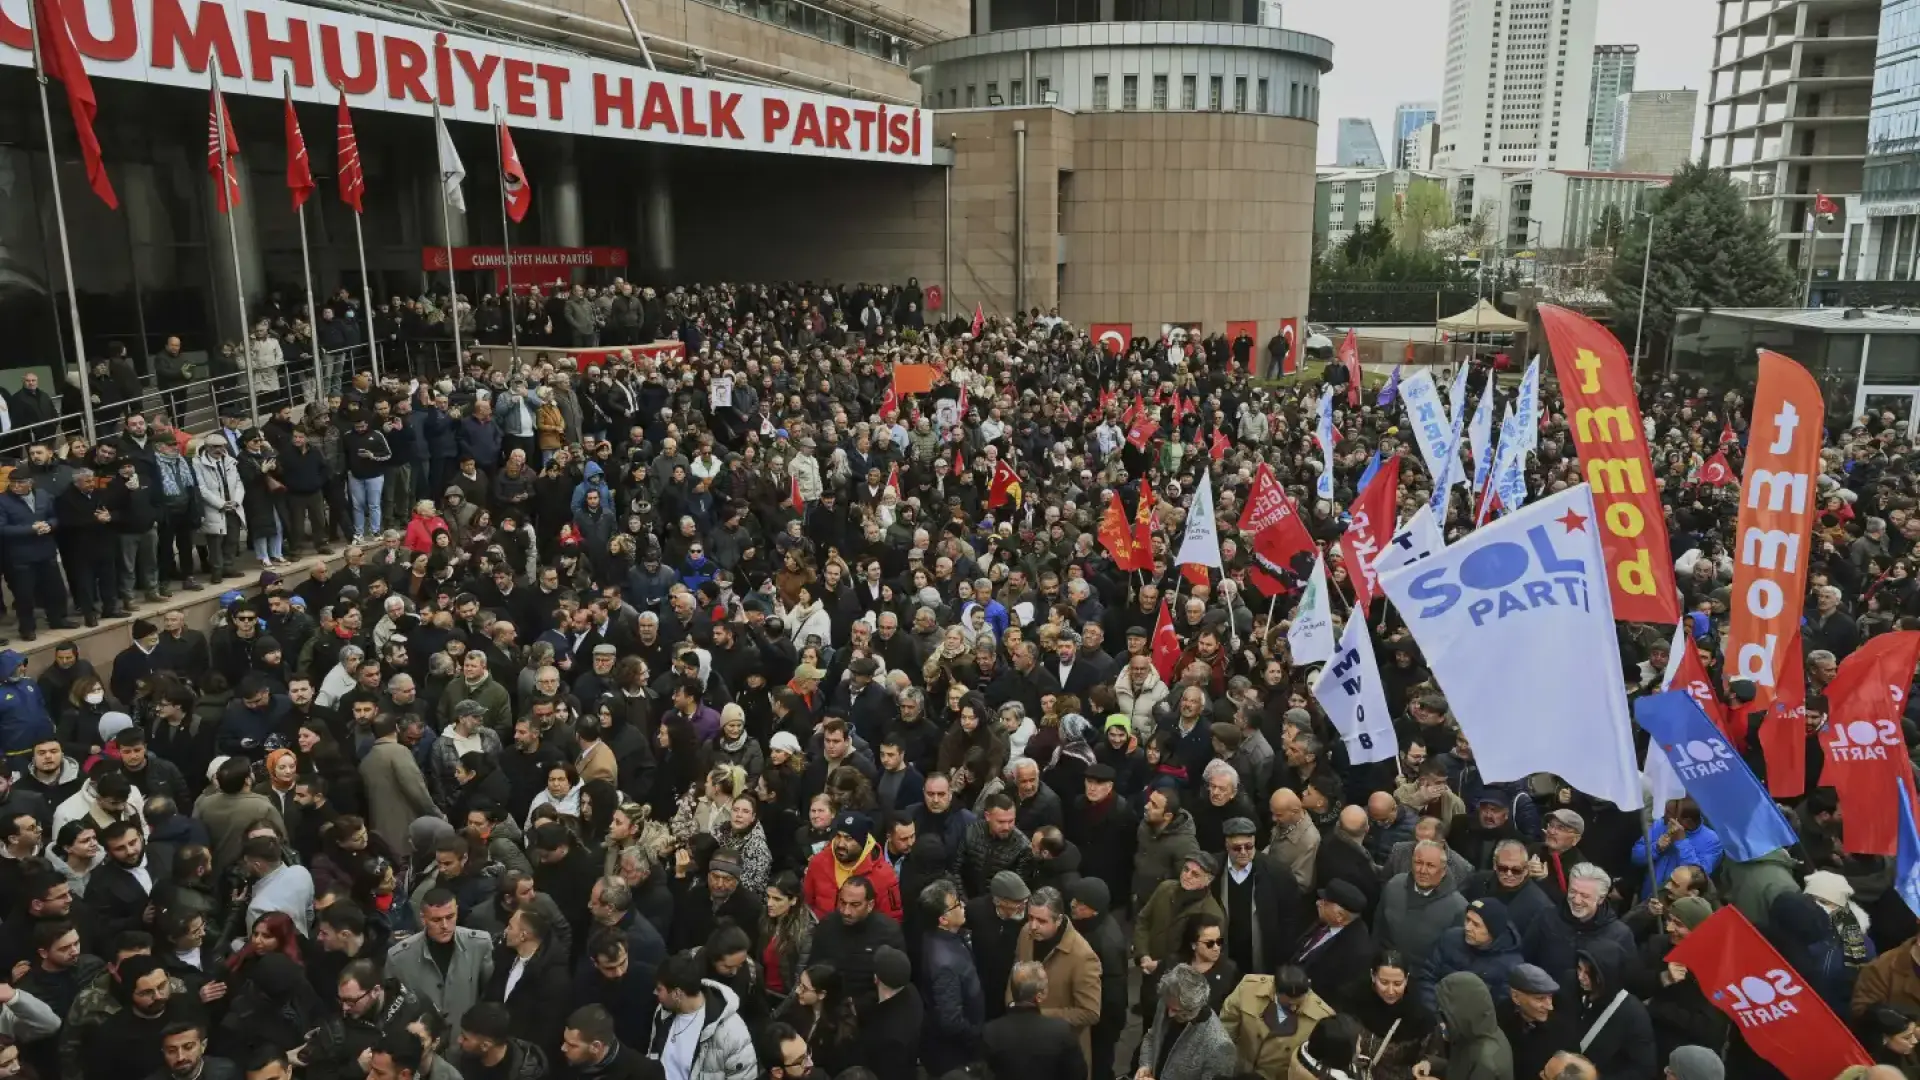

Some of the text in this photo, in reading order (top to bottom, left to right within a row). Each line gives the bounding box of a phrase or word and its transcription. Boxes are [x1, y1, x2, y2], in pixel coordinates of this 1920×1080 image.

[593, 72, 746, 140] HALK
[763, 97, 921, 157] PARTİSİ
[535, 254, 559, 265] HALK
[560, 250, 593, 265] PARTİSİ
[1408, 524, 1587, 619] SOL
